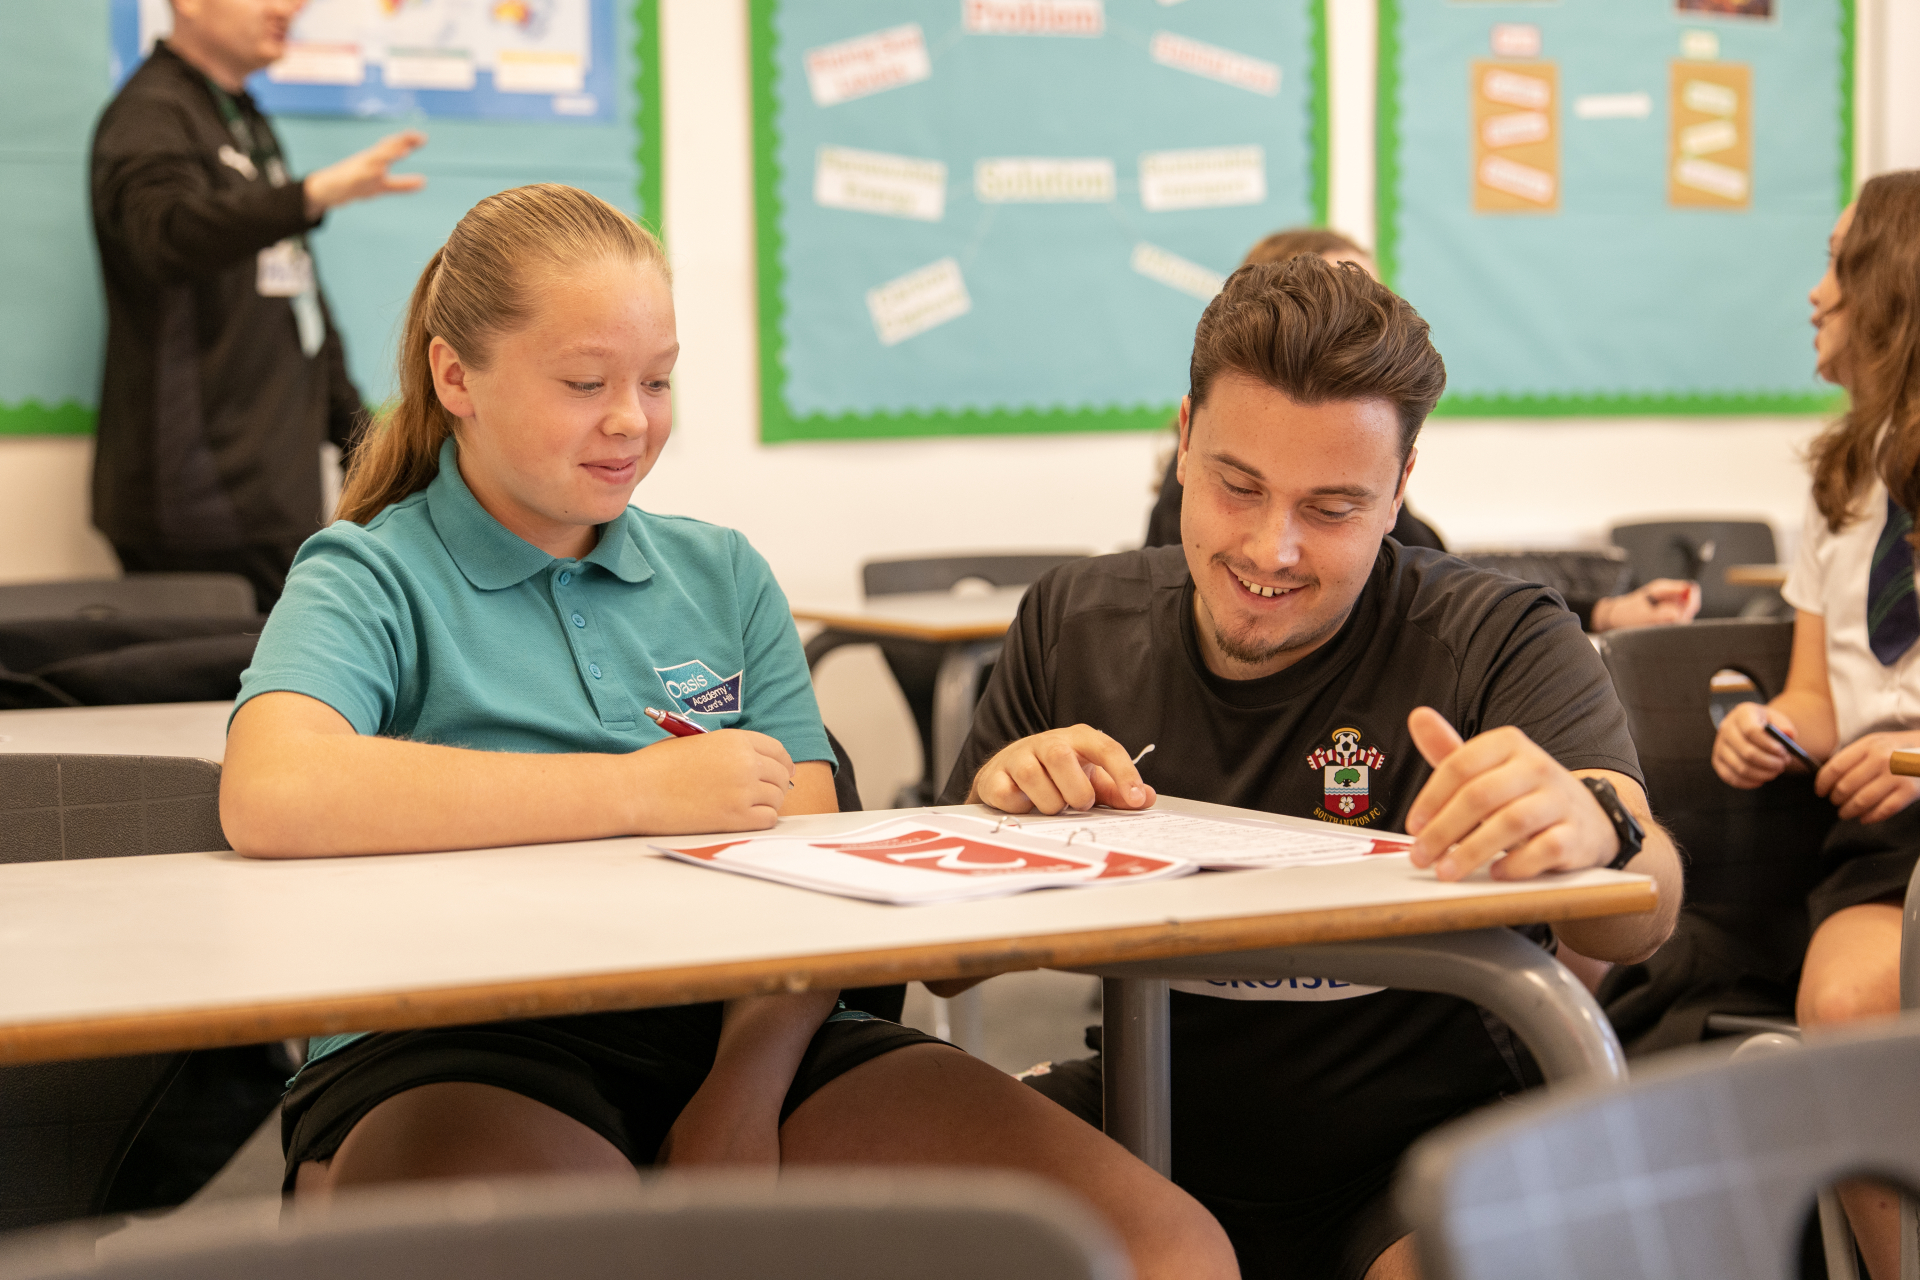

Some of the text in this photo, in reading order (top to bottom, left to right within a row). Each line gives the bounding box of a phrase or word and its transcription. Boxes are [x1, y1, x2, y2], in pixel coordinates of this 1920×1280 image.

[969, 0, 1097, 31] Problem
[981, 163, 1109, 195] Solution
[666, 674, 708, 698] Oasis
[692, 686, 727, 706] Academy
[722, 693, 735, 703] Hill
[1313, 807, 1381, 826] SOUTHAMPTON FC
